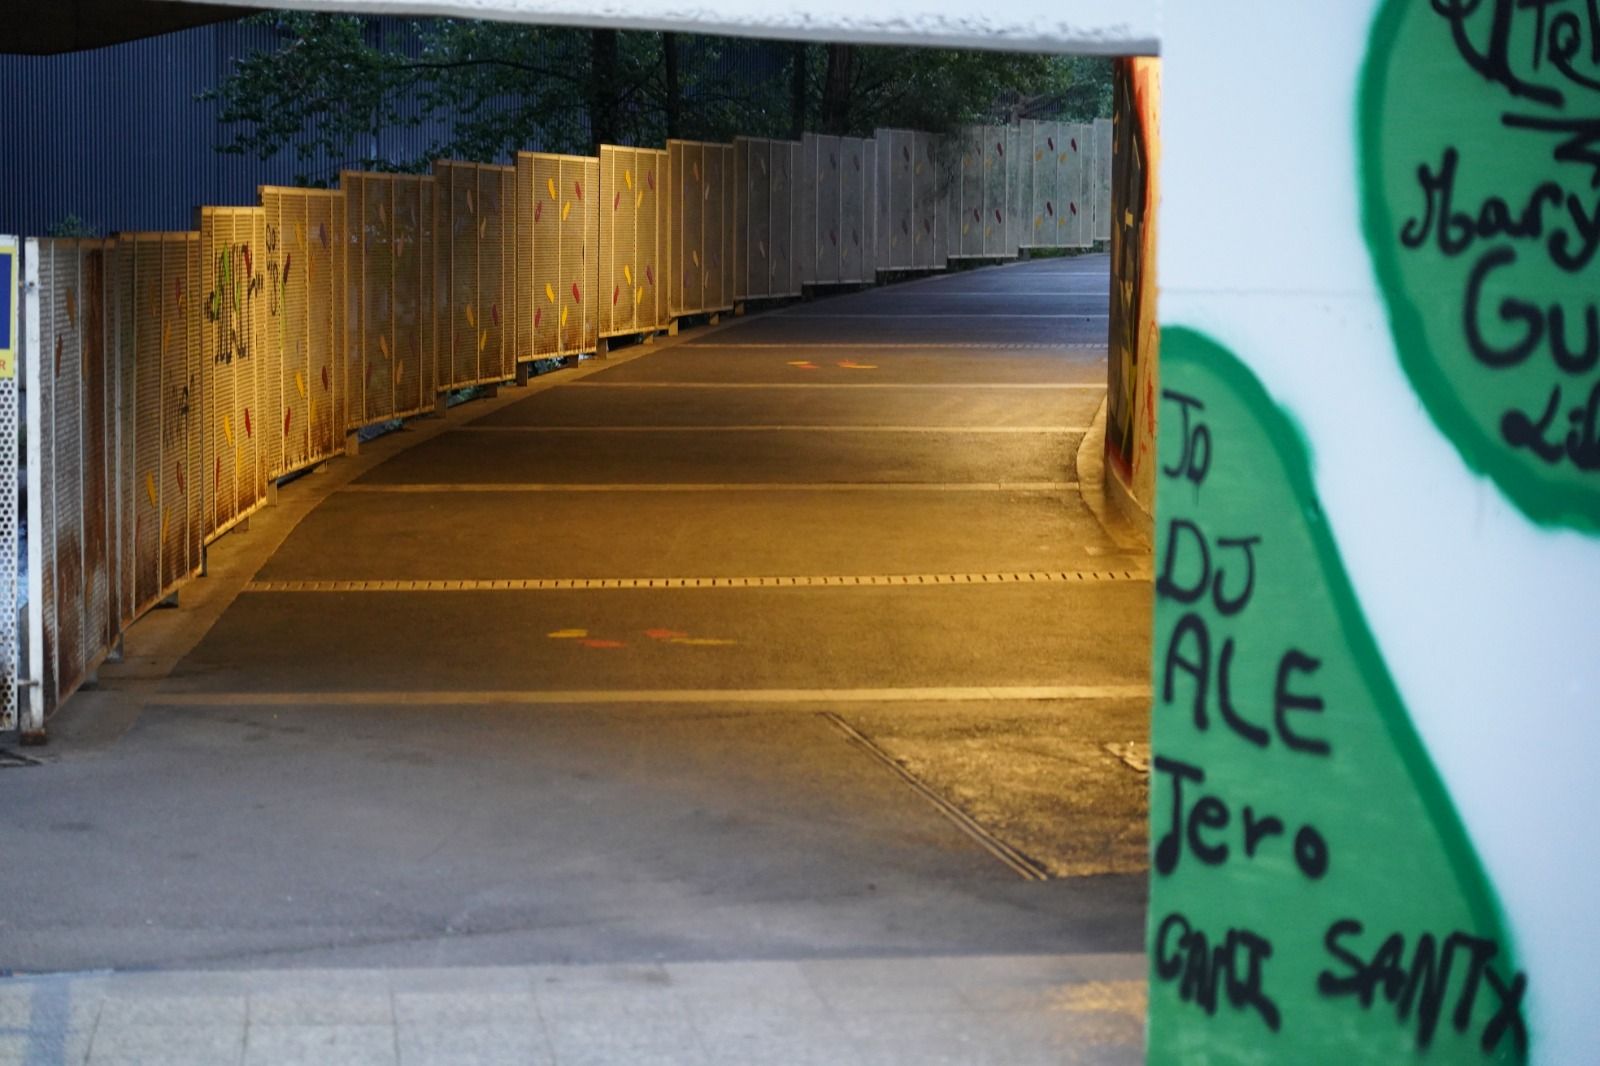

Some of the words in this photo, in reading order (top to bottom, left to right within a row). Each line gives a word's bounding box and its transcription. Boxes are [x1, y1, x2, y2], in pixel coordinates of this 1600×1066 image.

[1155, 518, 1261, 618] DJ
[1163, 613, 1331, 757] ALE
[1154, 755, 1330, 881] Jero
